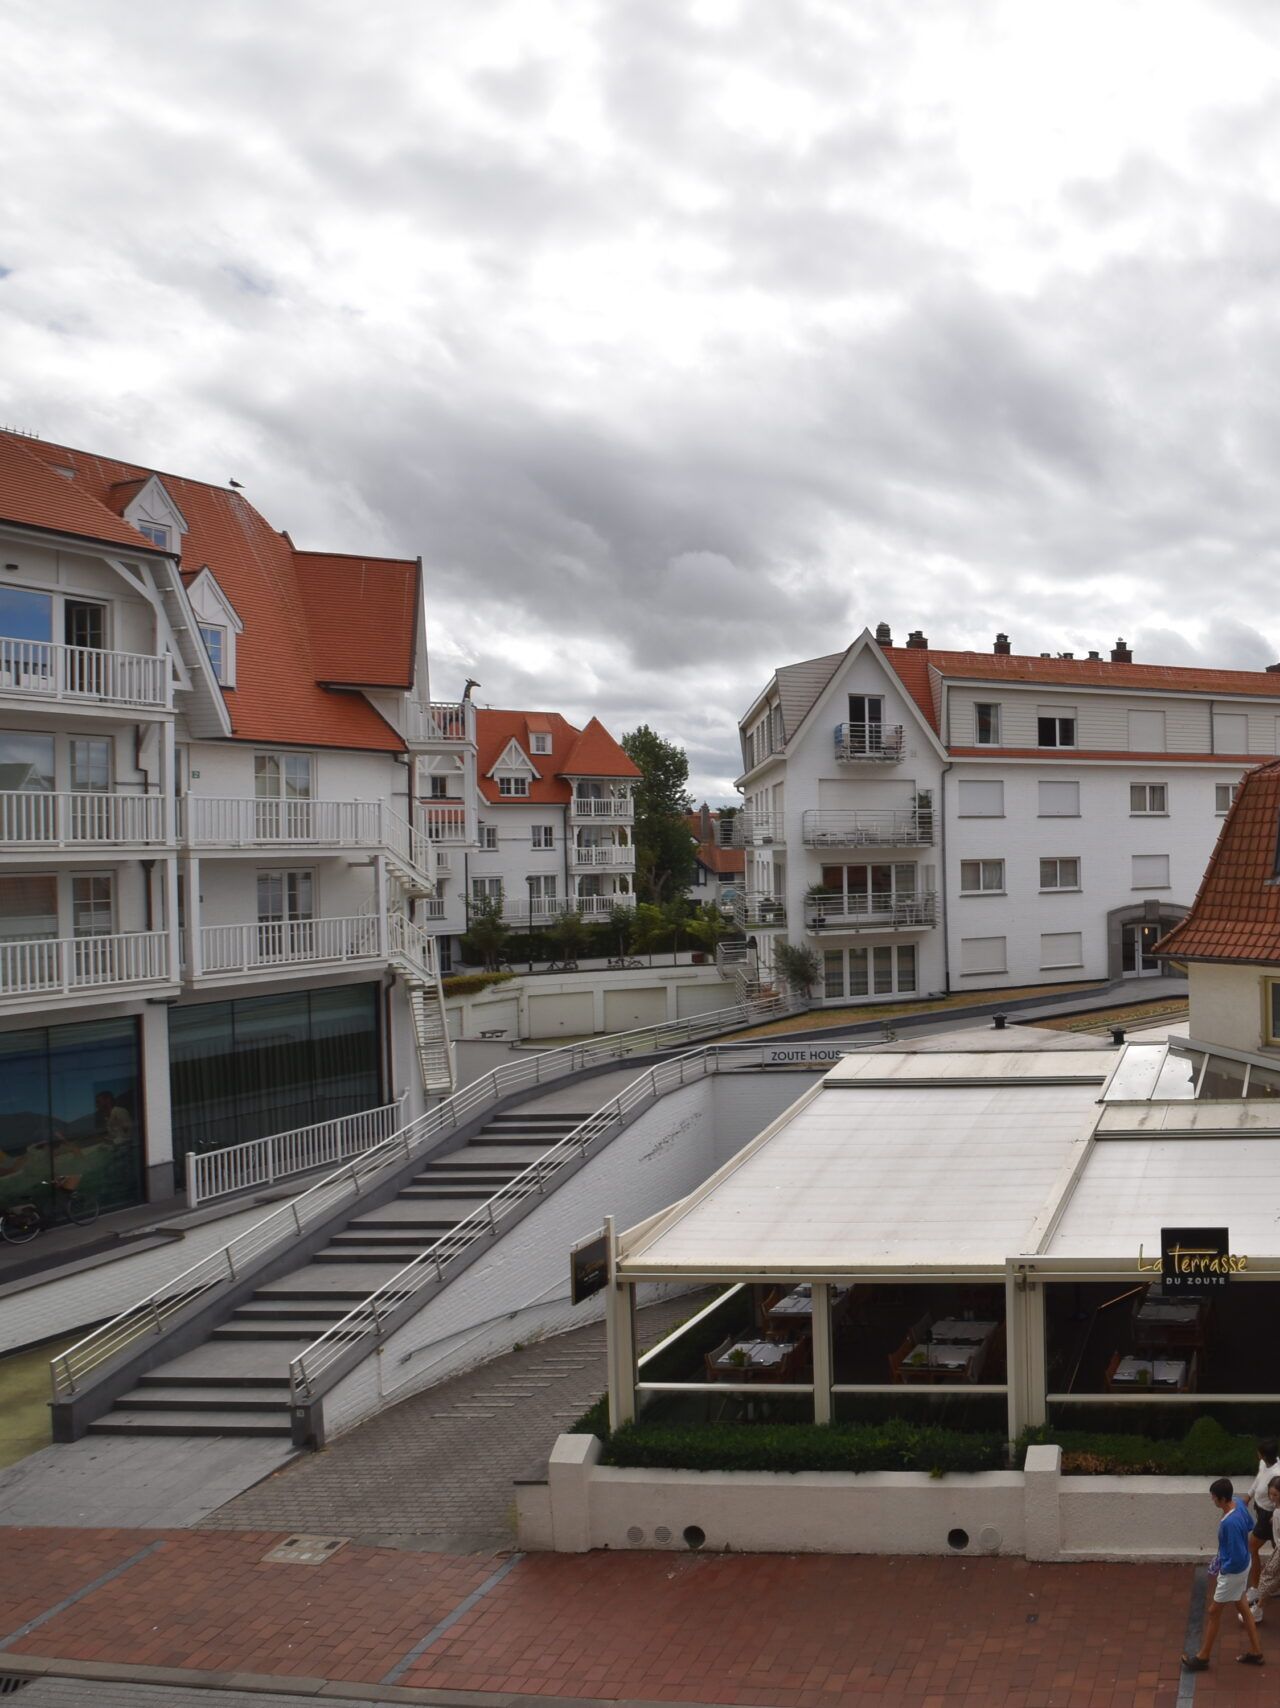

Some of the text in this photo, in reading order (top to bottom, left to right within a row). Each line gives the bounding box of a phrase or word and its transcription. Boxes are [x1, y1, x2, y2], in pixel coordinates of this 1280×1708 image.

[770, 1051, 806, 1061] ZOUTE
[1137, 1242, 1248, 1274] La Terrasse
[1166, 1277, 1225, 1285] DU ZOUTE
